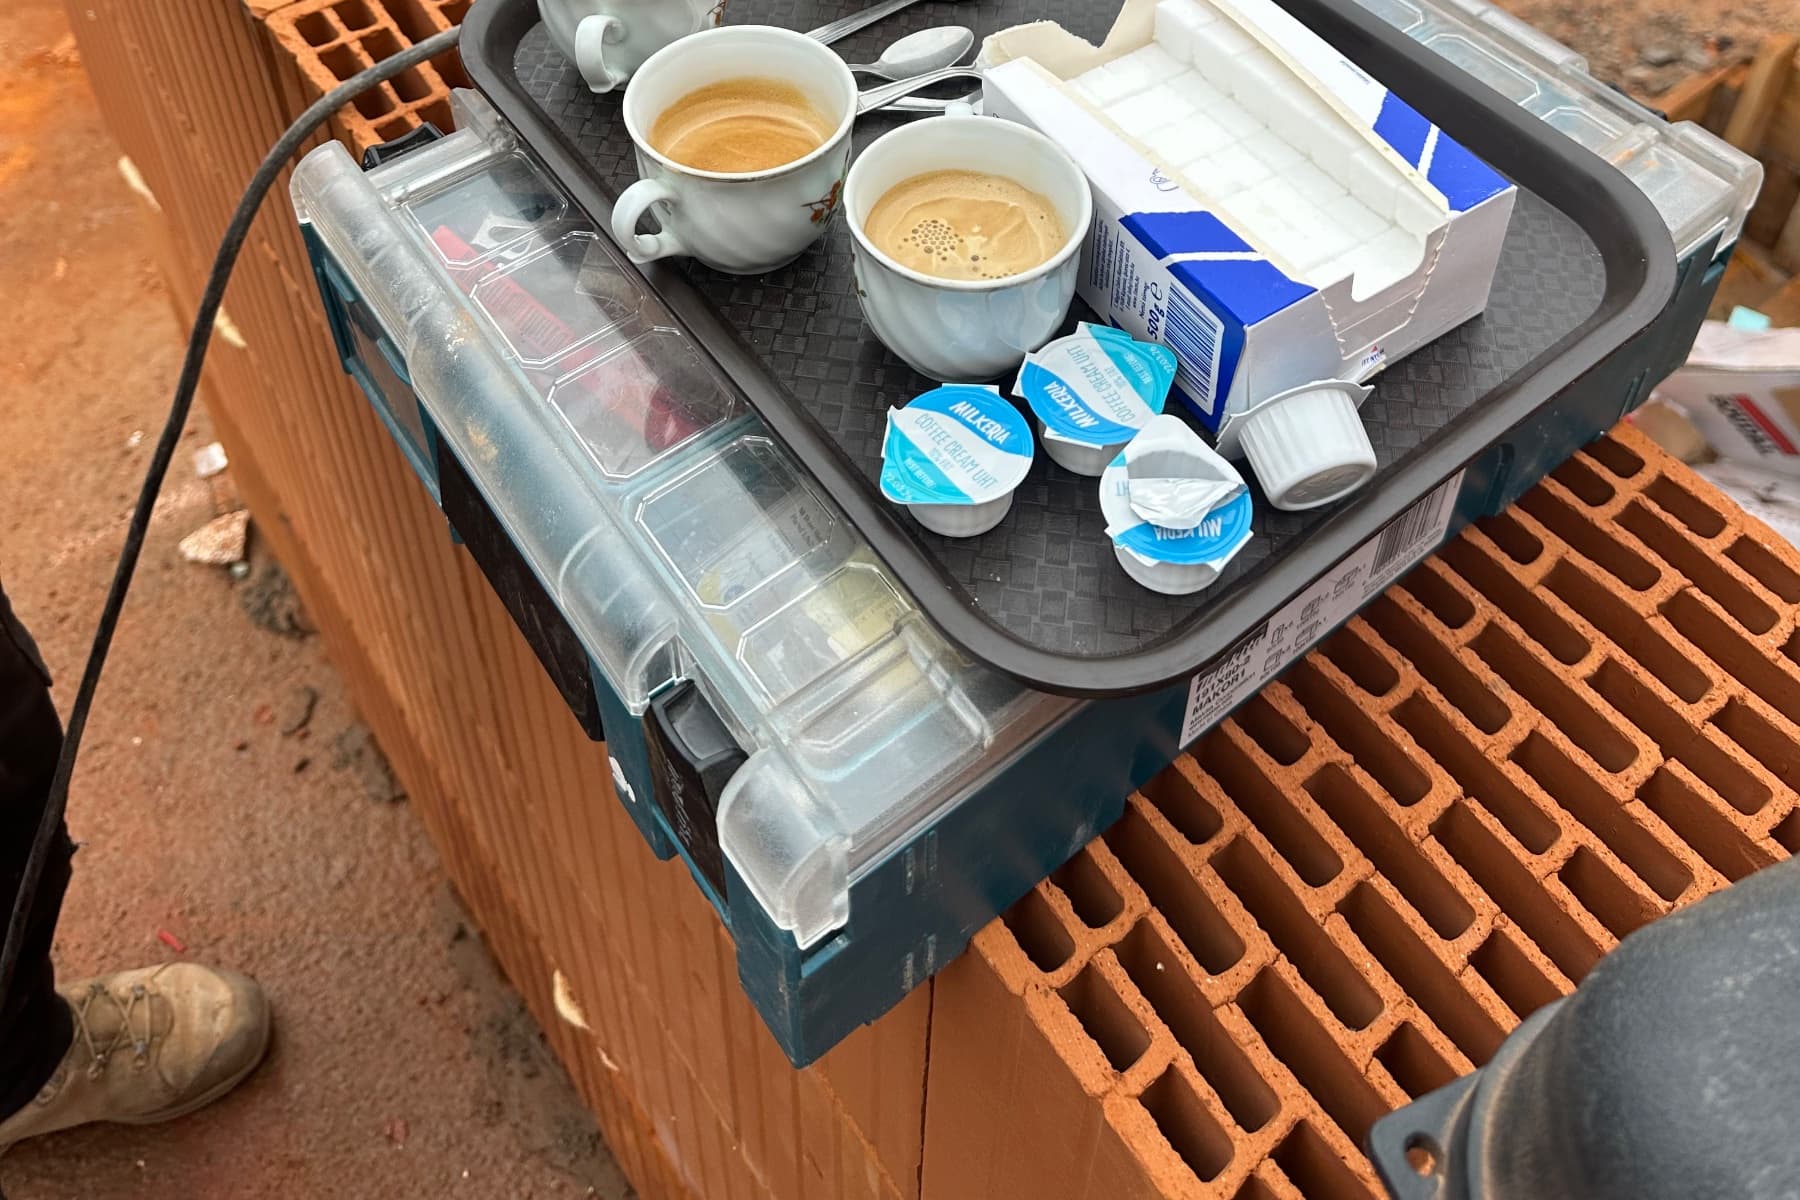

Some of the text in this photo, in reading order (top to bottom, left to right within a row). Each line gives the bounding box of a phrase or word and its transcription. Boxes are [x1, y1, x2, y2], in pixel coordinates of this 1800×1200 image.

[1043, 380, 1099, 428] MILKERIA
[1066, 345, 1136, 423] COFFEE CREAM UHT
[915, 413, 999, 489] COFFEE CREAM UHT
[948, 401, 1011, 445] MILKERIA
